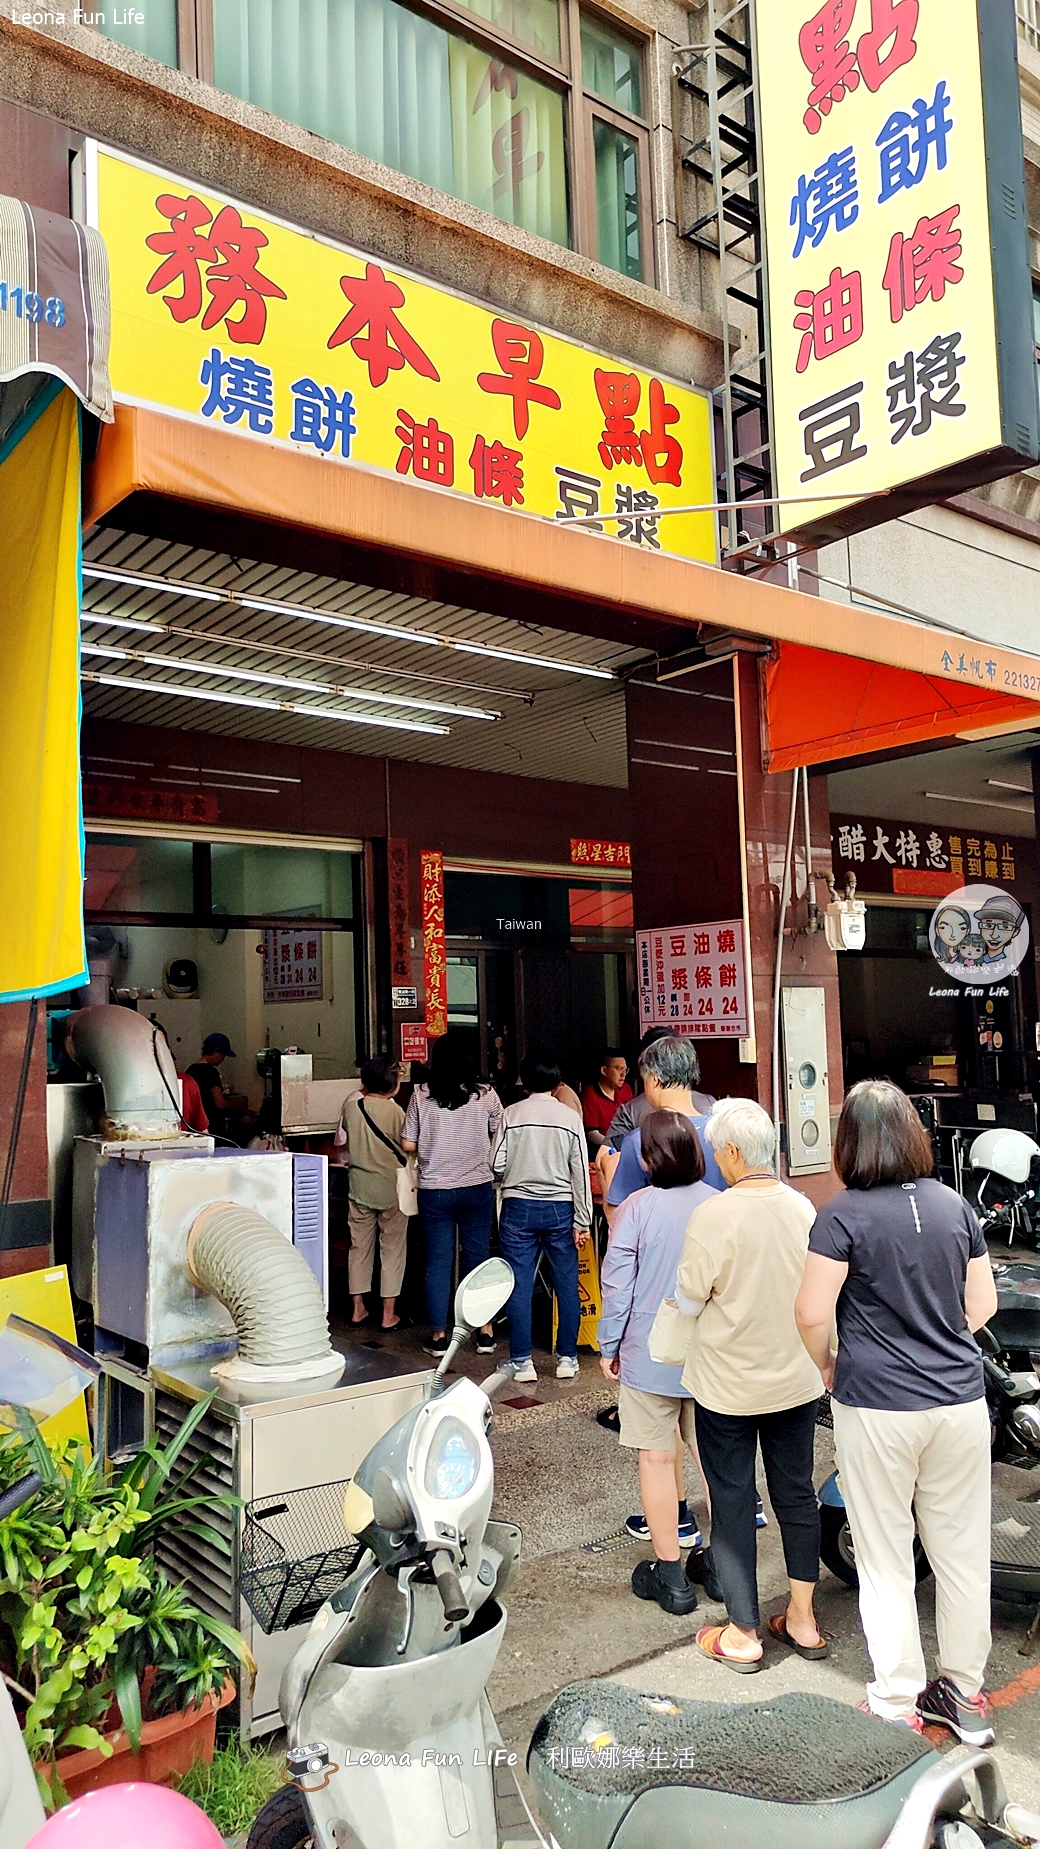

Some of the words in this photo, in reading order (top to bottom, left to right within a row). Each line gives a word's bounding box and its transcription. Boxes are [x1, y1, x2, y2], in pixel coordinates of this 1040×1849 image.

[789, 80, 953, 259] 燒餅
[793, 204, 965, 373] 油條
[146, 193, 683, 488] 務本早點
[200, 348, 357, 459] 燒餅
[395, 409, 525, 506] 油條
[555, 466, 661, 549] 豆漿
[799, 332, 966, 483] 豆漿
[830, 823, 948, 869] 醋大特惠
[670, 1005, 680, 1017] 28
[683, 1004, 693, 1016] 24
[698, 997, 713, 1016] 24
[722, 996, 738, 1015] 24
